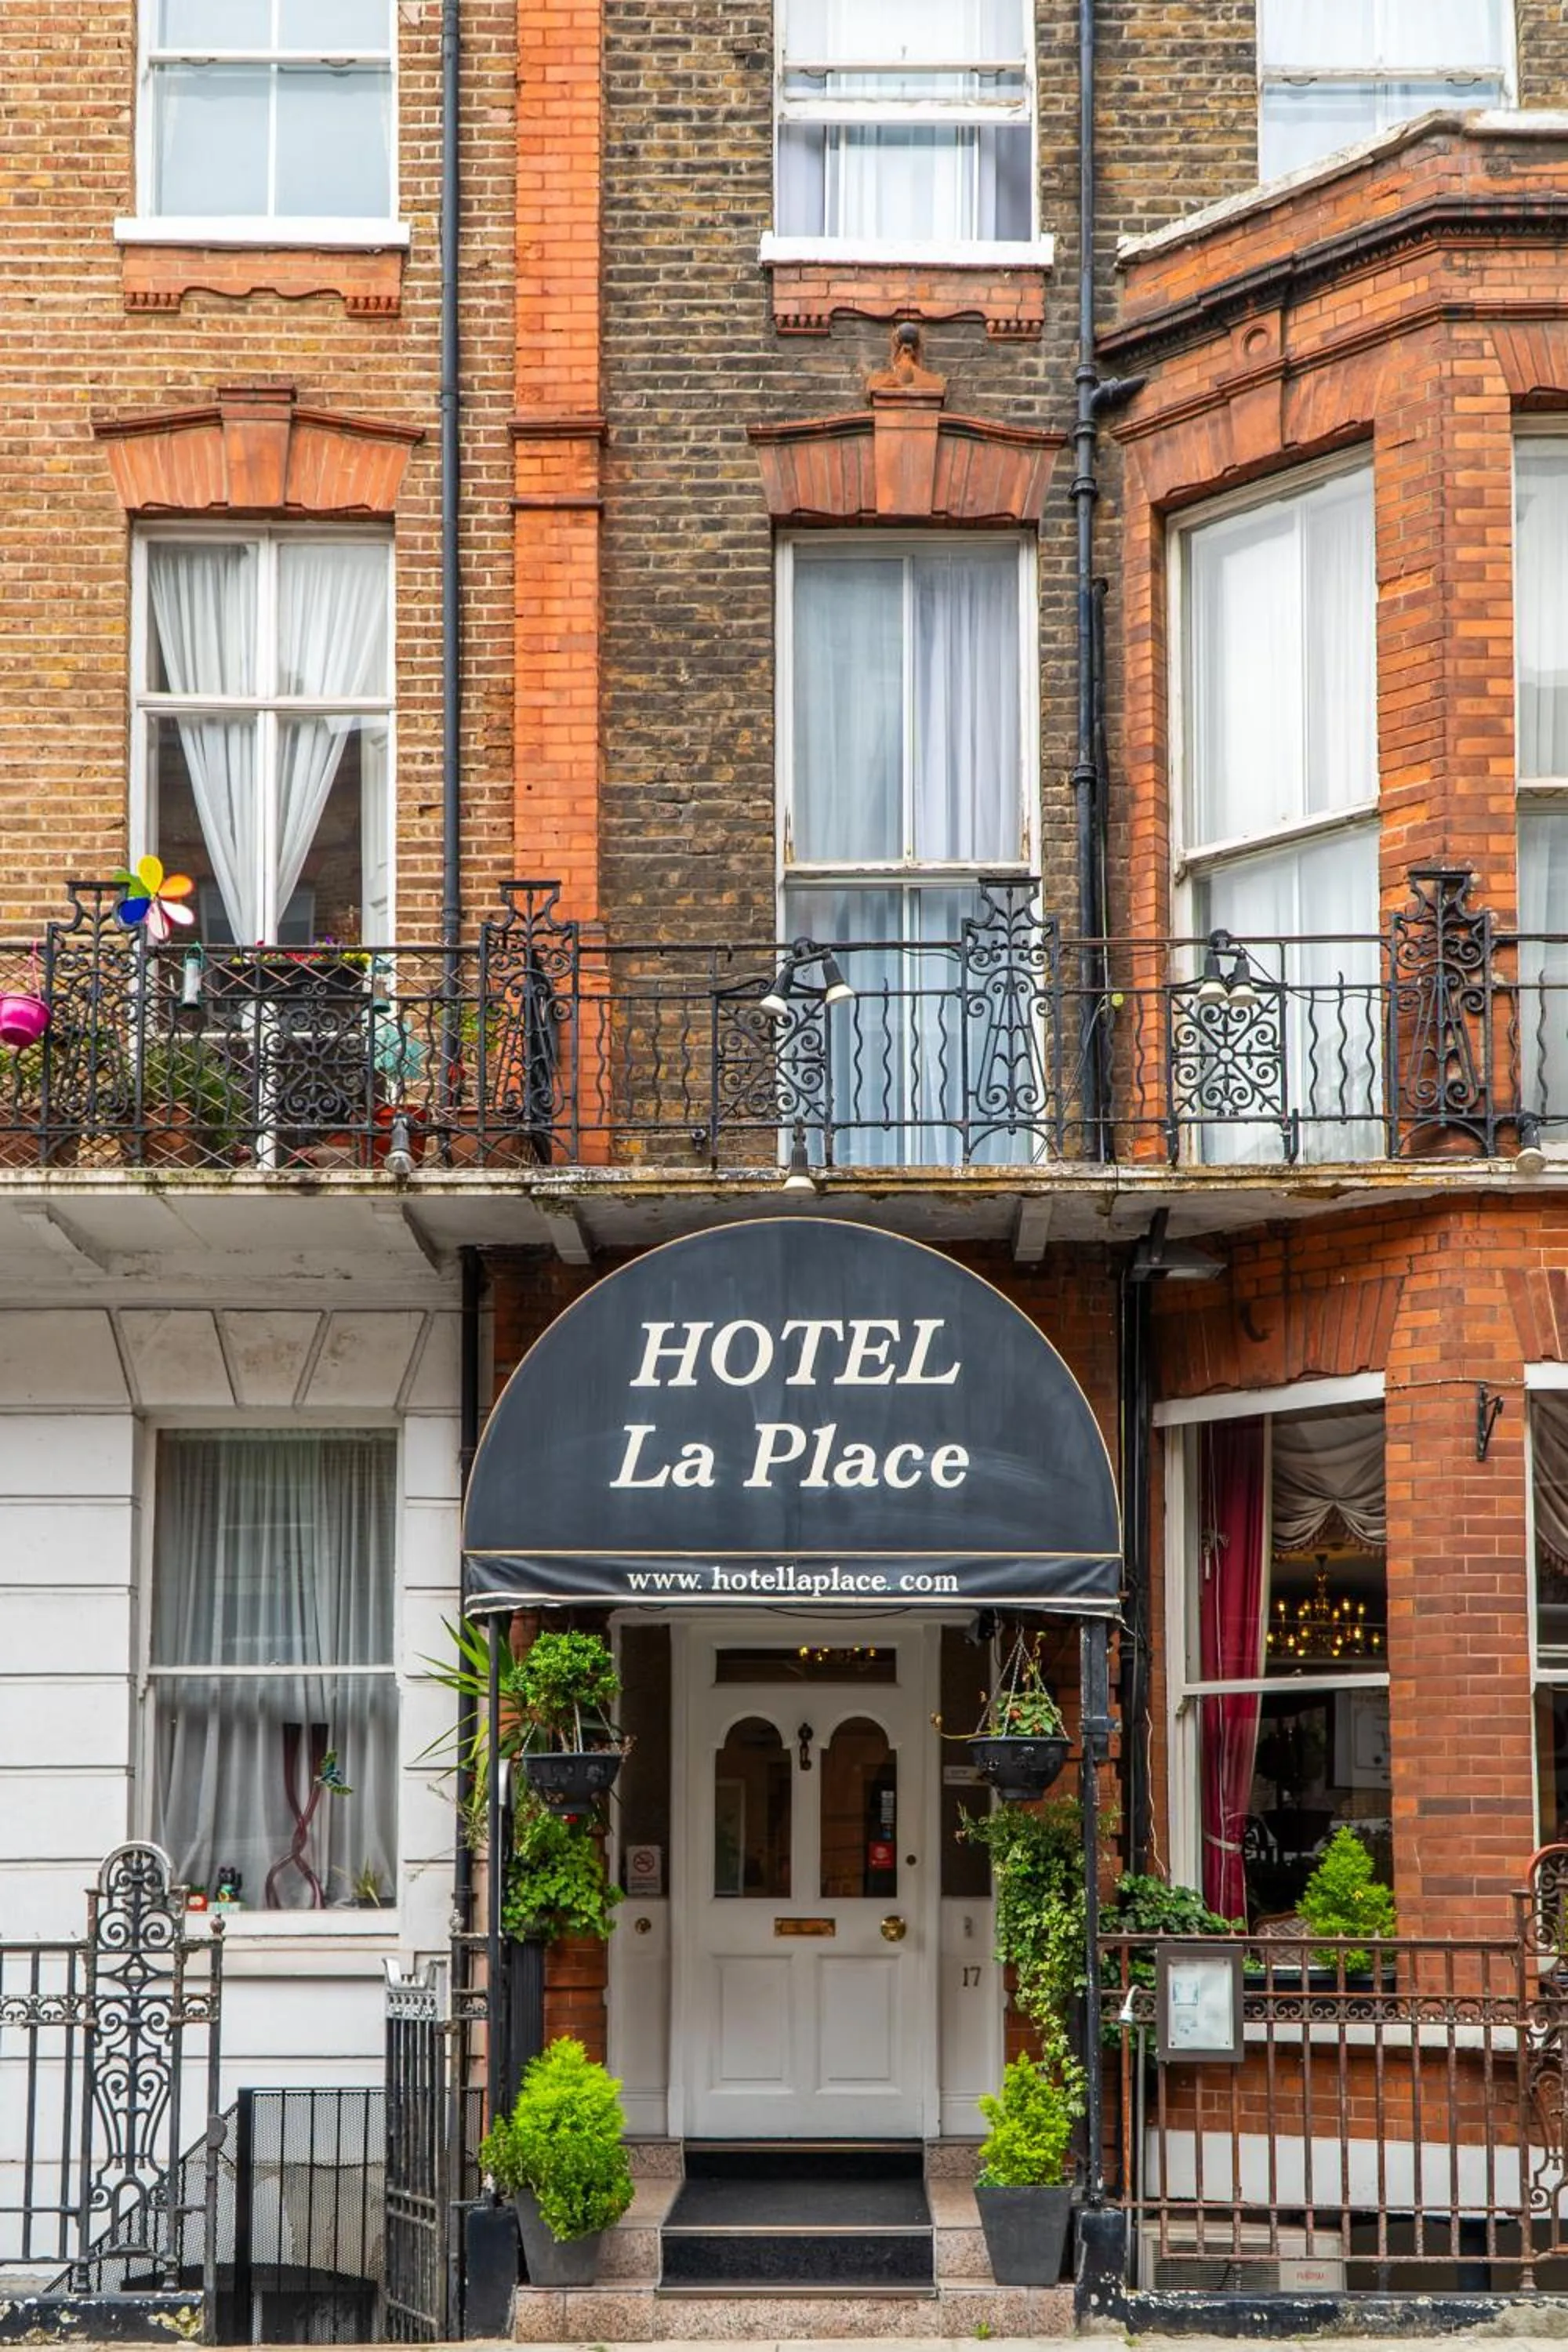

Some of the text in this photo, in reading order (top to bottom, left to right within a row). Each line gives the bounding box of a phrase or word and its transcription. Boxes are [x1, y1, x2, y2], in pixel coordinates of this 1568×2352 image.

[628, 1318, 961, 1388] HOTEL
[608, 1422, 970, 1490] La Place
[963, 1966, 982, 1987] 17
